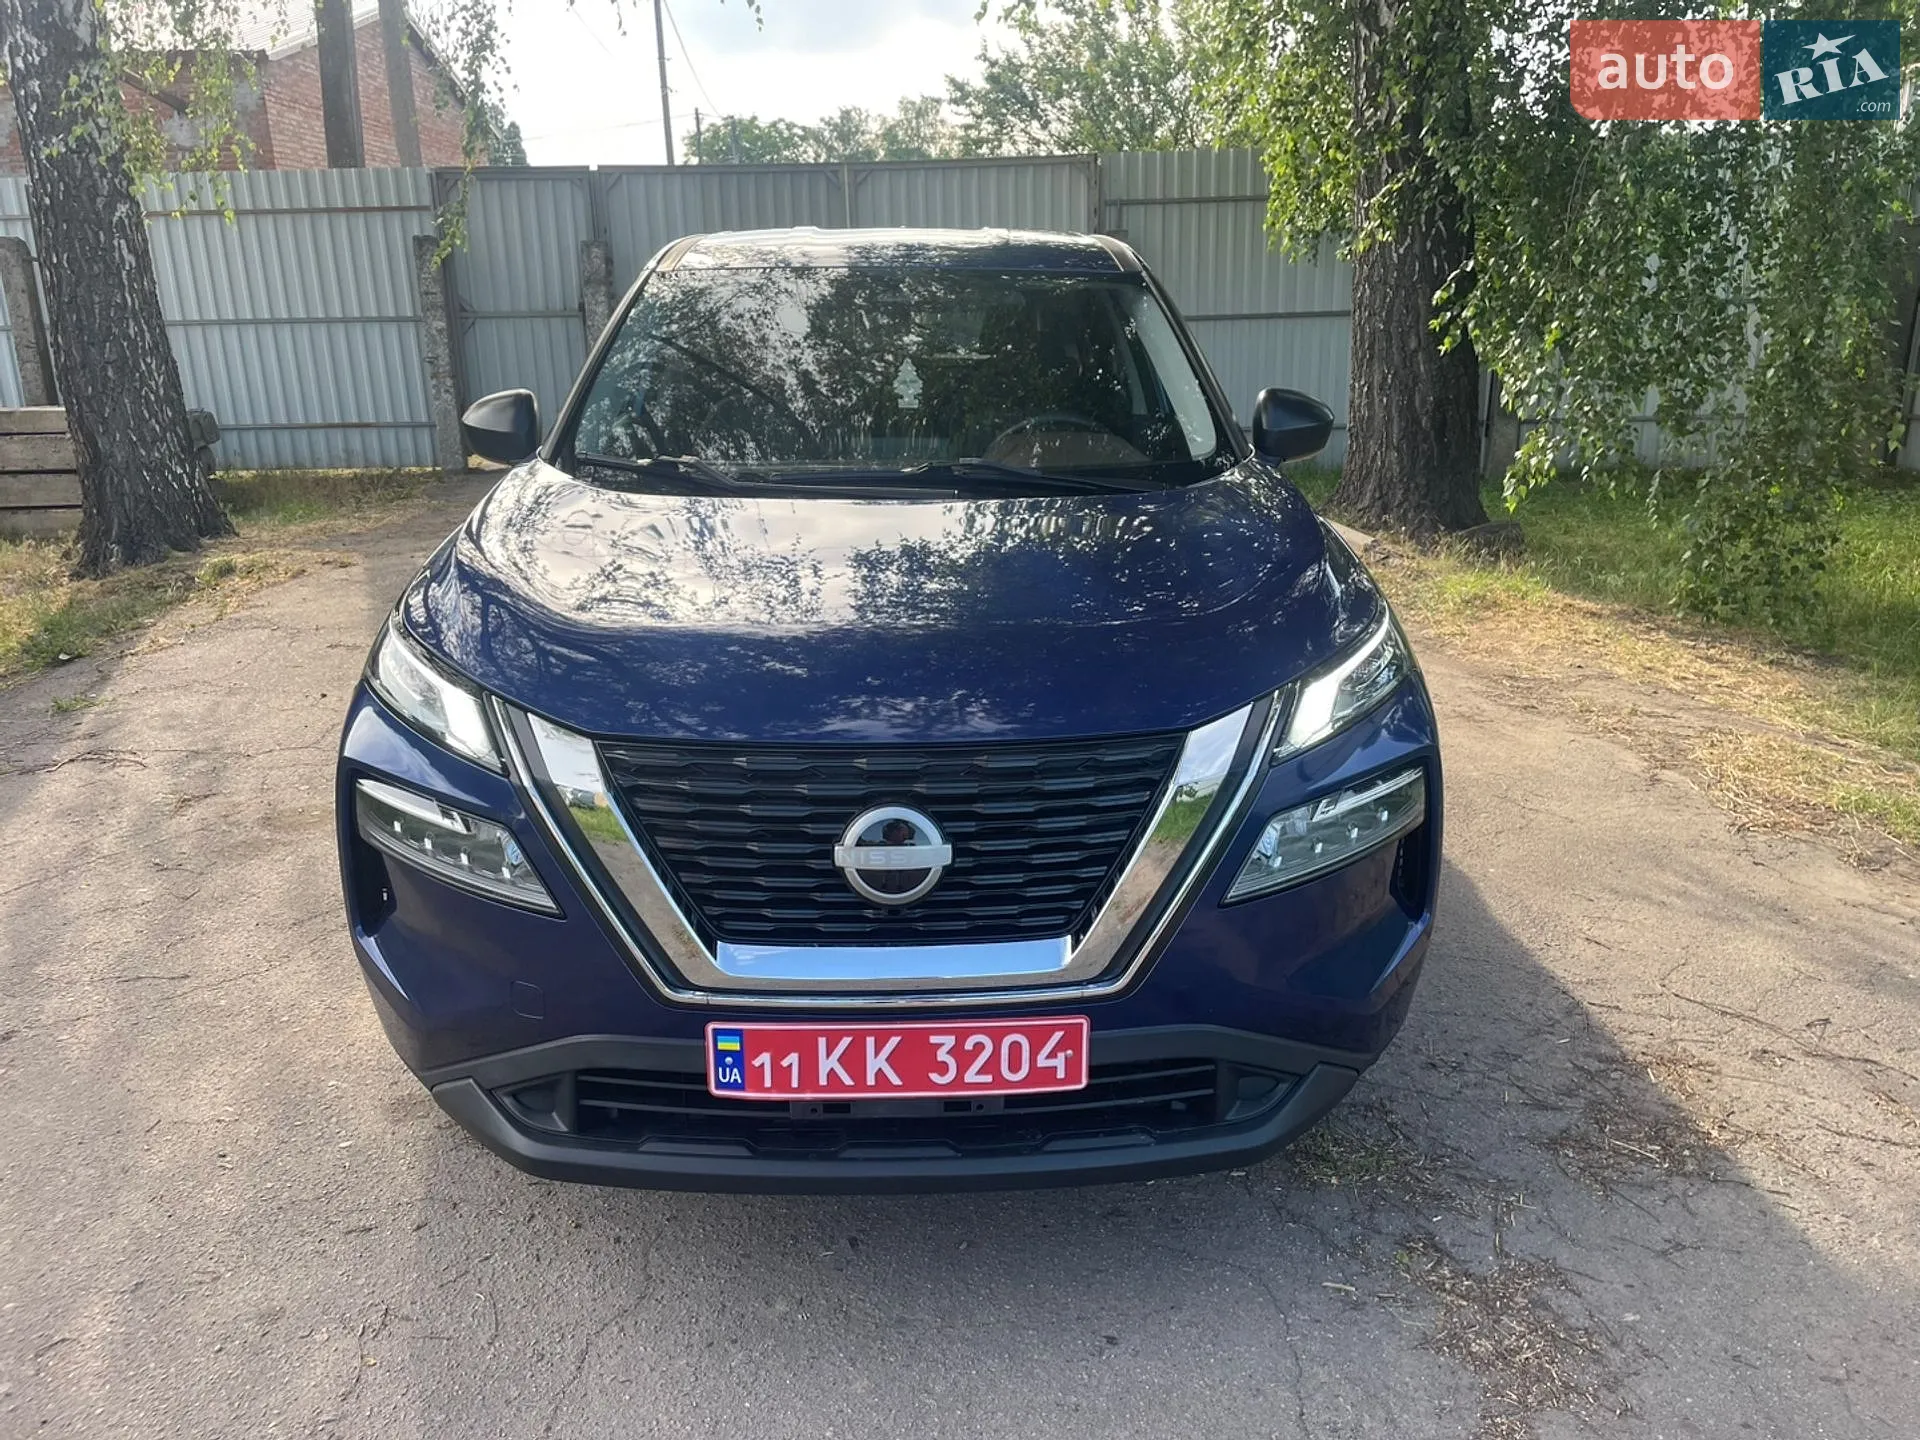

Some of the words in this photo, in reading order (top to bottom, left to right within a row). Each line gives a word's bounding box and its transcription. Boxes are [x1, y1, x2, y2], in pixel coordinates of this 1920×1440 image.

[718, 1067, 742, 1083] UA
[751, 1052, 800, 1088] 11
[817, 1036, 904, 1086] KK
[928, 1031, 1066, 1085] 3204
